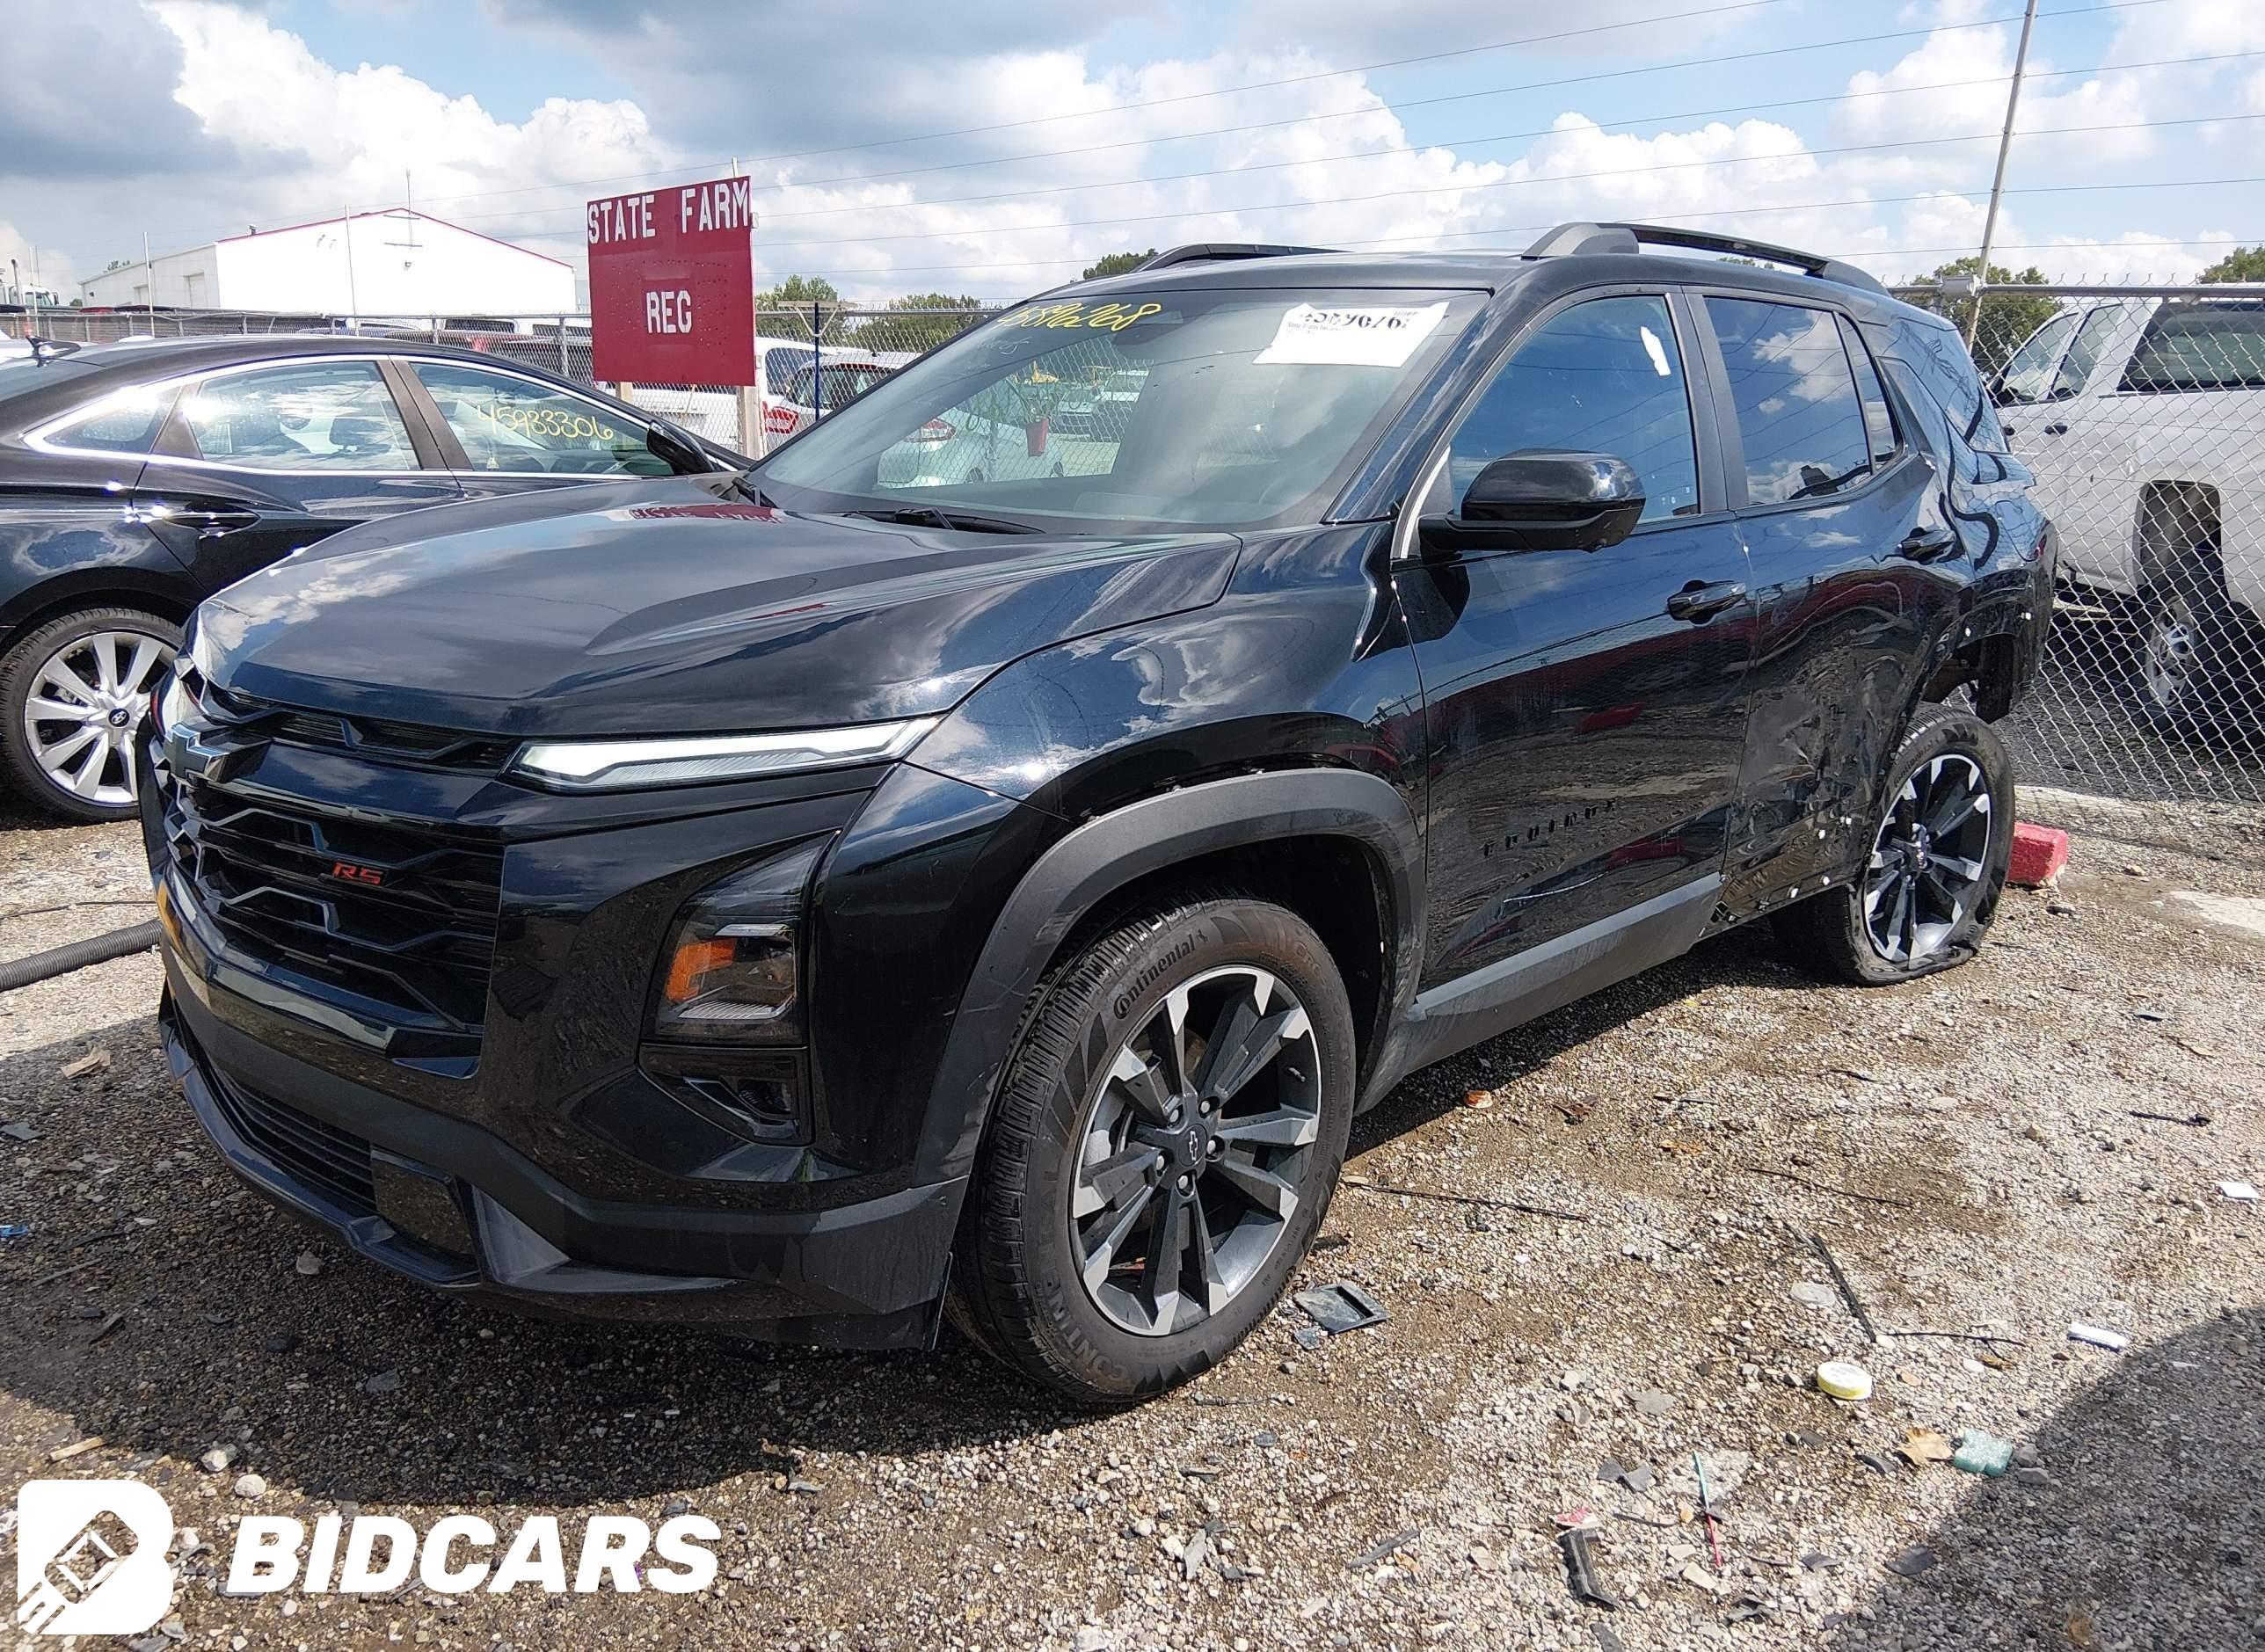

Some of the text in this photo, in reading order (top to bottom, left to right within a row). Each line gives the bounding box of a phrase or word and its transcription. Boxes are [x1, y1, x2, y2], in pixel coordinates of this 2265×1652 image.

[587, 179, 749, 244] STATE FARM
[646, 289, 693, 334] REG
[477, 404, 614, 440] 45933306
[332, 862, 384, 884] RS
[1113, 933, 1196, 1020] Continental
